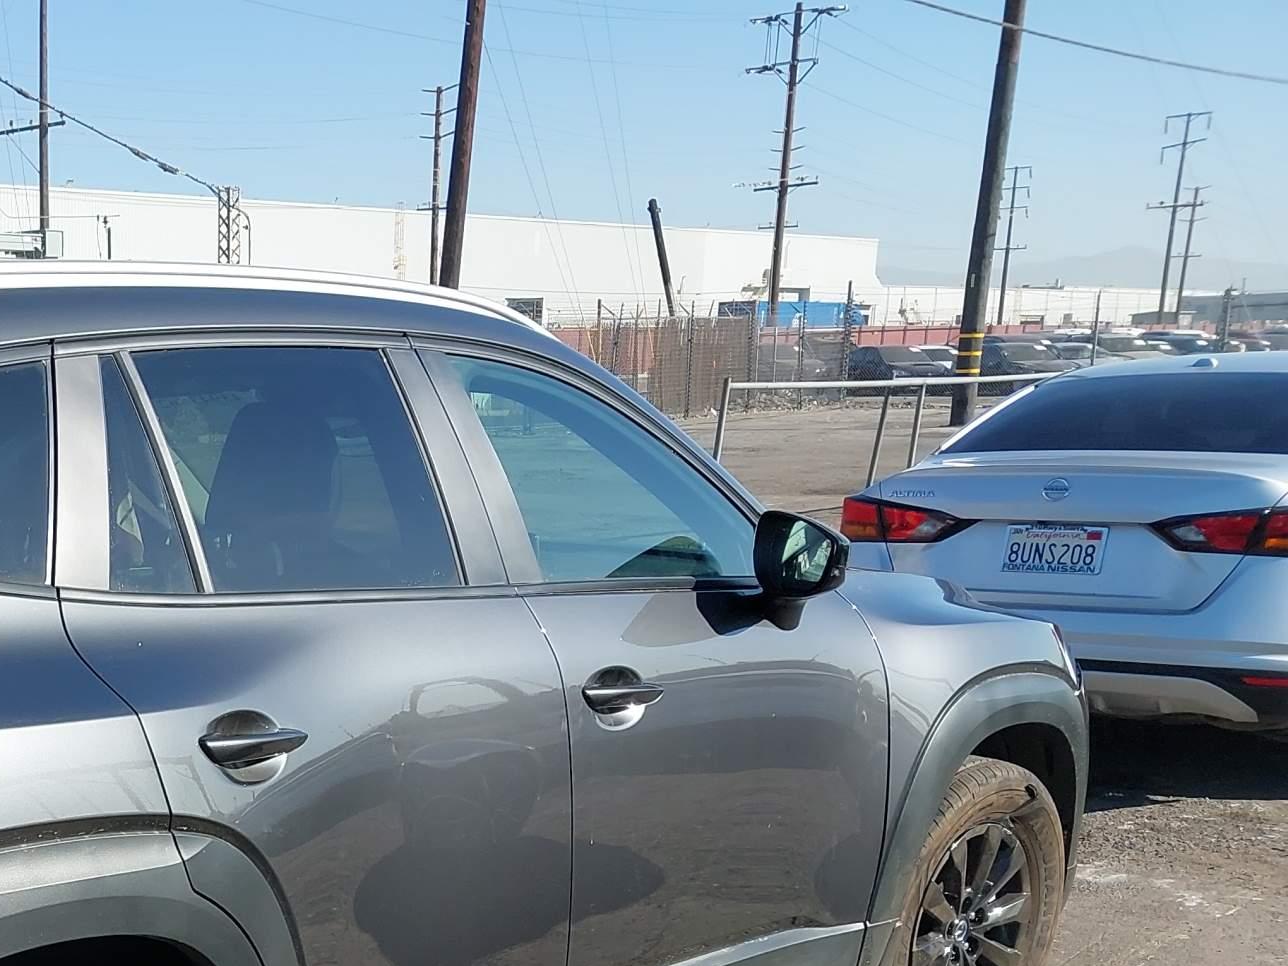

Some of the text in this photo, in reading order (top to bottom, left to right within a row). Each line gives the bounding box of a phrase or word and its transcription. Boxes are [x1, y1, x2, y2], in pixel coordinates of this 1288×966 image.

[1008, 542, 1096, 566] 8UNS208
[1002, 562, 1096, 573] FONTANA NISSAN
